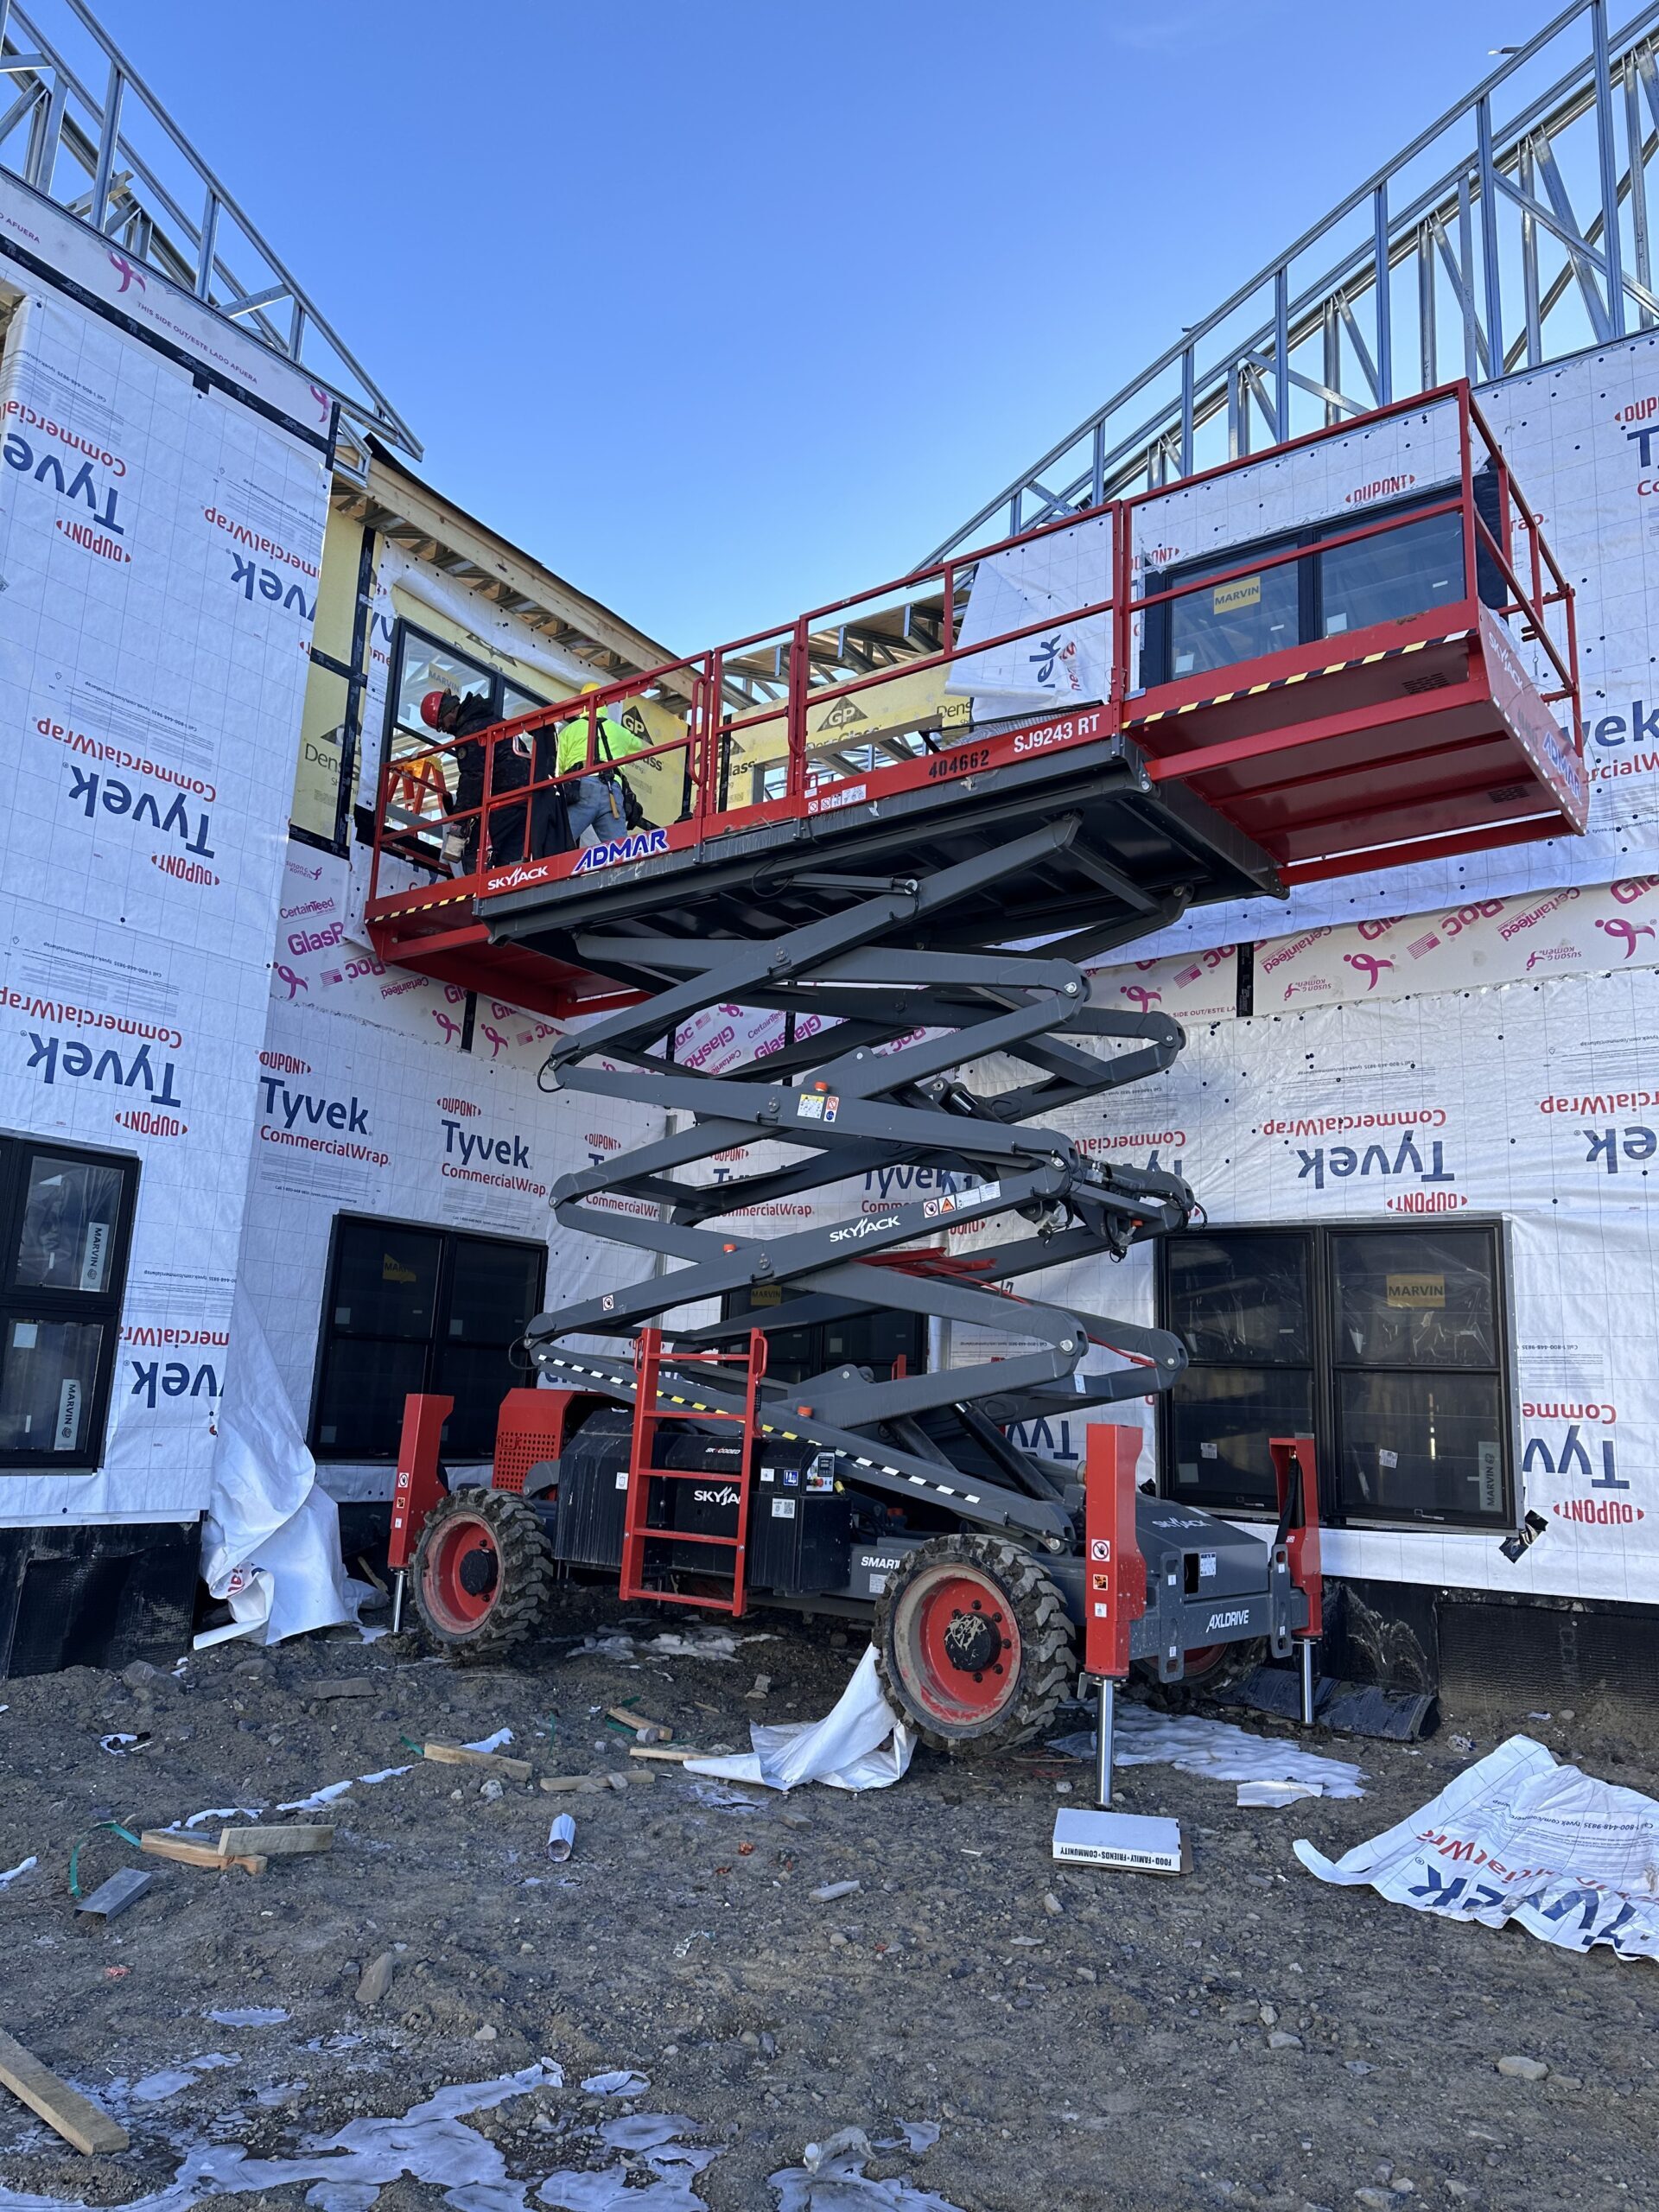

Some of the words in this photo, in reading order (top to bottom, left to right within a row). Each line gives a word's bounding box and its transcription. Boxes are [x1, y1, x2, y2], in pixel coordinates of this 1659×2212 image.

[6, 218, 40, 244] AFUERA
[137, 302, 154, 315] THIS
[155, 312, 172, 327] SIDE
[173, 326, 208, 352] OUT/ESTE
[209, 346, 229, 365] LADO
[231, 362, 257, 384] AFUERA
[1354, 474, 1408, 503] DUPONT
[64, 520, 123, 563] DUPONT
[204, 507, 321, 580] mercialWrap
[1215, 585, 1260, 606] MARVIN
[428, 670, 460, 692] MARVIN
[623, 715, 645, 734] GP
[829, 707, 855, 726] GP
[1014, 722, 1073, 753] SJ9243
[1078, 714, 1100, 735] RT
[37, 718, 216, 803] CommercialWrap
[929, 748, 990, 779] 404662
[68, 765, 215, 859] Tyvek
[572, 829, 670, 875] ADMAR
[159, 855, 212, 886] DUPONT
[488, 865, 549, 890] SKYJACK
[280, 898, 335, 919] CertainTeed
[1500, 887, 1581, 943] CertainTeed
[1264, 925, 1333, 975] CertainTeed
[1556, 951, 1582, 962] susan
[381, 976, 429, 1000] CertainTeed
[1309, 982, 1332, 991] susan
[1191, 1007, 1225, 1017] OUT/ESTE
[27, 1032, 181, 1108] Tyvek
[262, 1052, 305, 1075] DUPONT
[260, 1076, 368, 1135] Tyvek
[442, 1098, 478, 1116] DUPONT
[123, 1111, 179, 1137] DUPONT
[1263, 1109, 1446, 1136] CommercialWrap
[260, 1125, 389, 1167] CommercialWrap
[442, 1119, 530, 1169] Tyvek
[588, 1133, 619, 1150] DUPONT
[1297, 1130, 1455, 1189] Tyvek
[442, 1163, 546, 1197] CommercialWrap
[1396, 1192, 1458, 1212] DUPONT
[830, 1215, 901, 1243] SKYJACK
[90, 1227, 103, 1268] MARVIN
[1389, 1284, 1444, 1298] MARVIN
[131, 1360, 224, 1408] vek
[63, 1382, 76, 1426] MARVIN
[694, 1486, 741, 1506] SKYJA
[1485, 1465, 1496, 1507] MARVIN
[1563, 1499, 1633, 1525] DUPONT
[1205, 1609, 1249, 1633] AXLDRIVE
[1059, 1847, 1098, 1859] COMMUNITY
[1101, 1851, 1127, 1860] FRIENDS
[1129, 1853, 1152, 1865] FAMILY
[1154, 1858, 1173, 1866] FOOD
